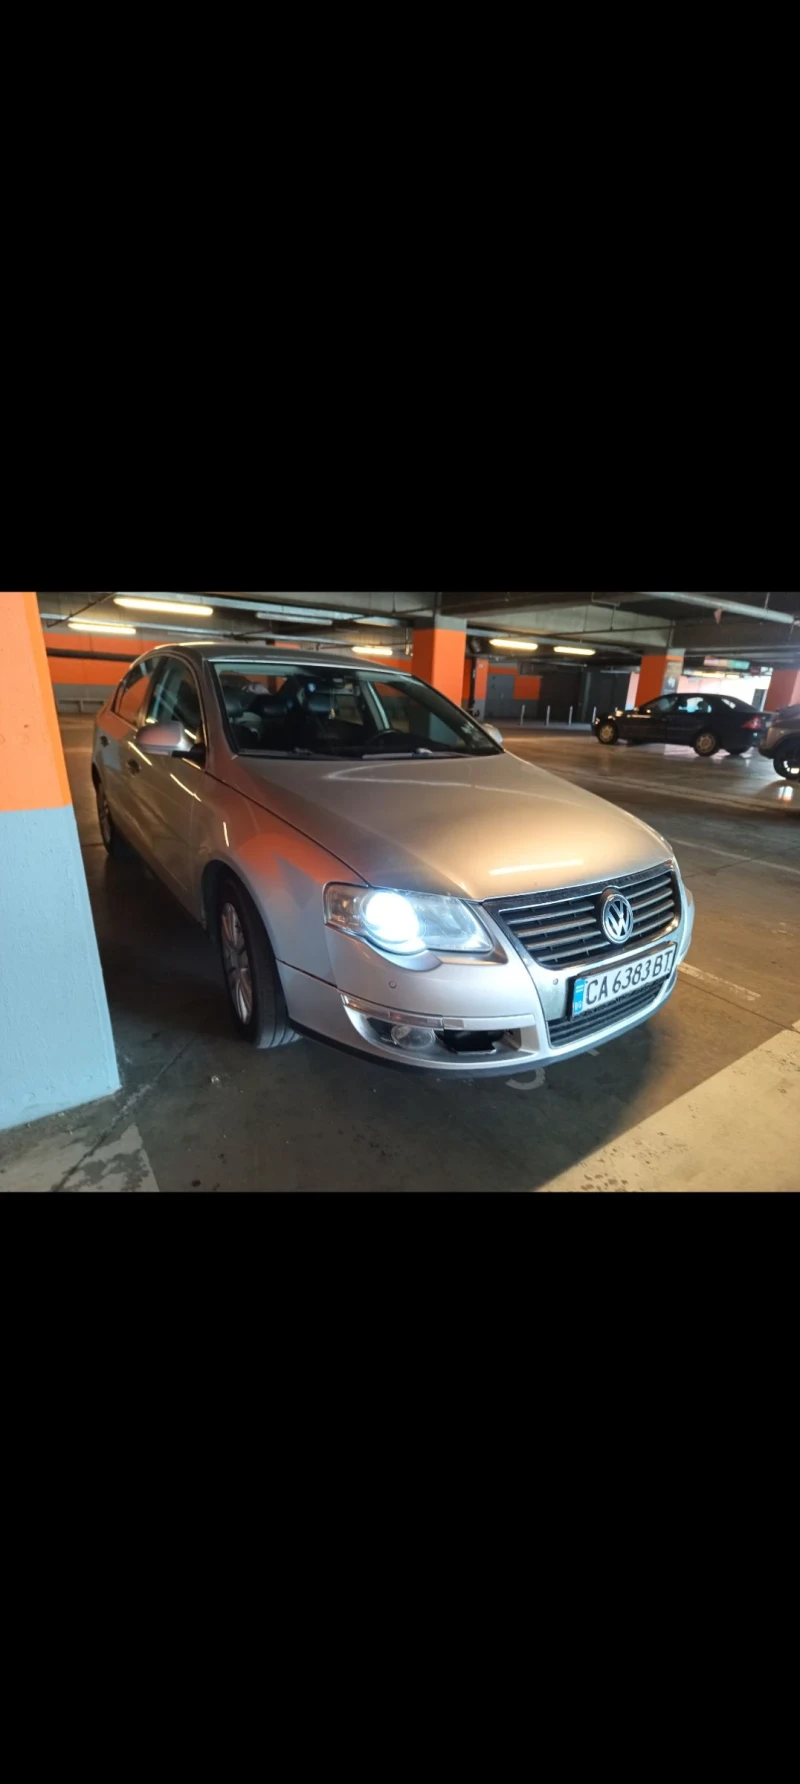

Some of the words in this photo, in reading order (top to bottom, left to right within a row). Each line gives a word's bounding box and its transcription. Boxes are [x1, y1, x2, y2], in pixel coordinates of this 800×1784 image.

[603, 895, 633, 943] VW
[586, 975, 609, 1005] CA
[612, 959, 652, 994] 6383
[652, 949, 673, 977] BT
